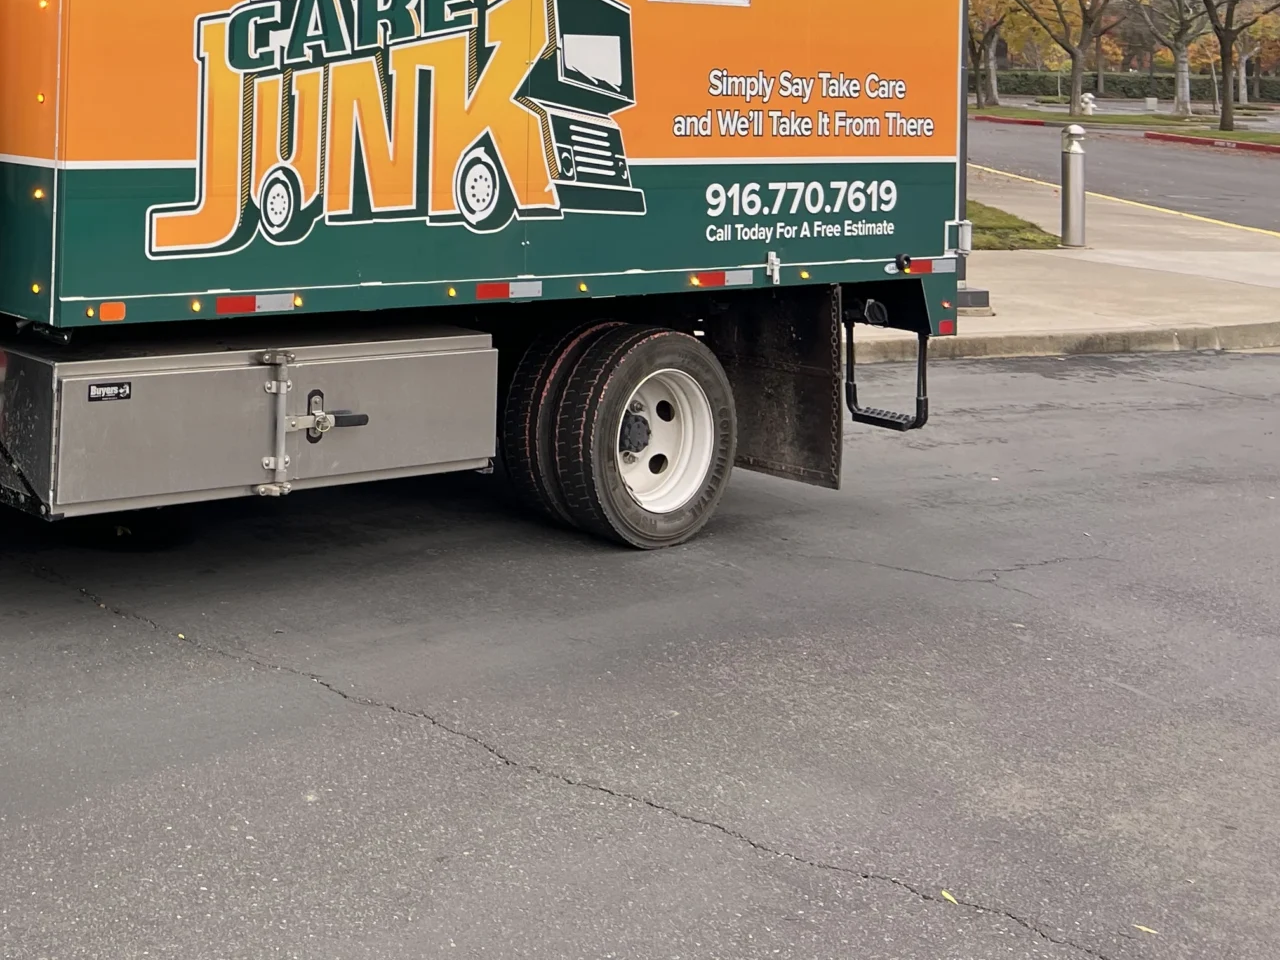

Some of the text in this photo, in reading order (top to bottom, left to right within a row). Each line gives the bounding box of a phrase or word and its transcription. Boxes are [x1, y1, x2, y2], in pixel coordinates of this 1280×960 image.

[708, 68, 907, 104] Simply Say Take Care
[673, 109, 712, 137] and
[768, 110, 813, 137] Take
[817, 111, 831, 136] It
[833, 111, 880, 137] From
[884, 112, 934, 137] There
[705, 179, 898, 217] 916.770.7619
[705, 219, 895, 243] Call Today For A Free Estimate
[90, 385, 119, 397] Buyers
